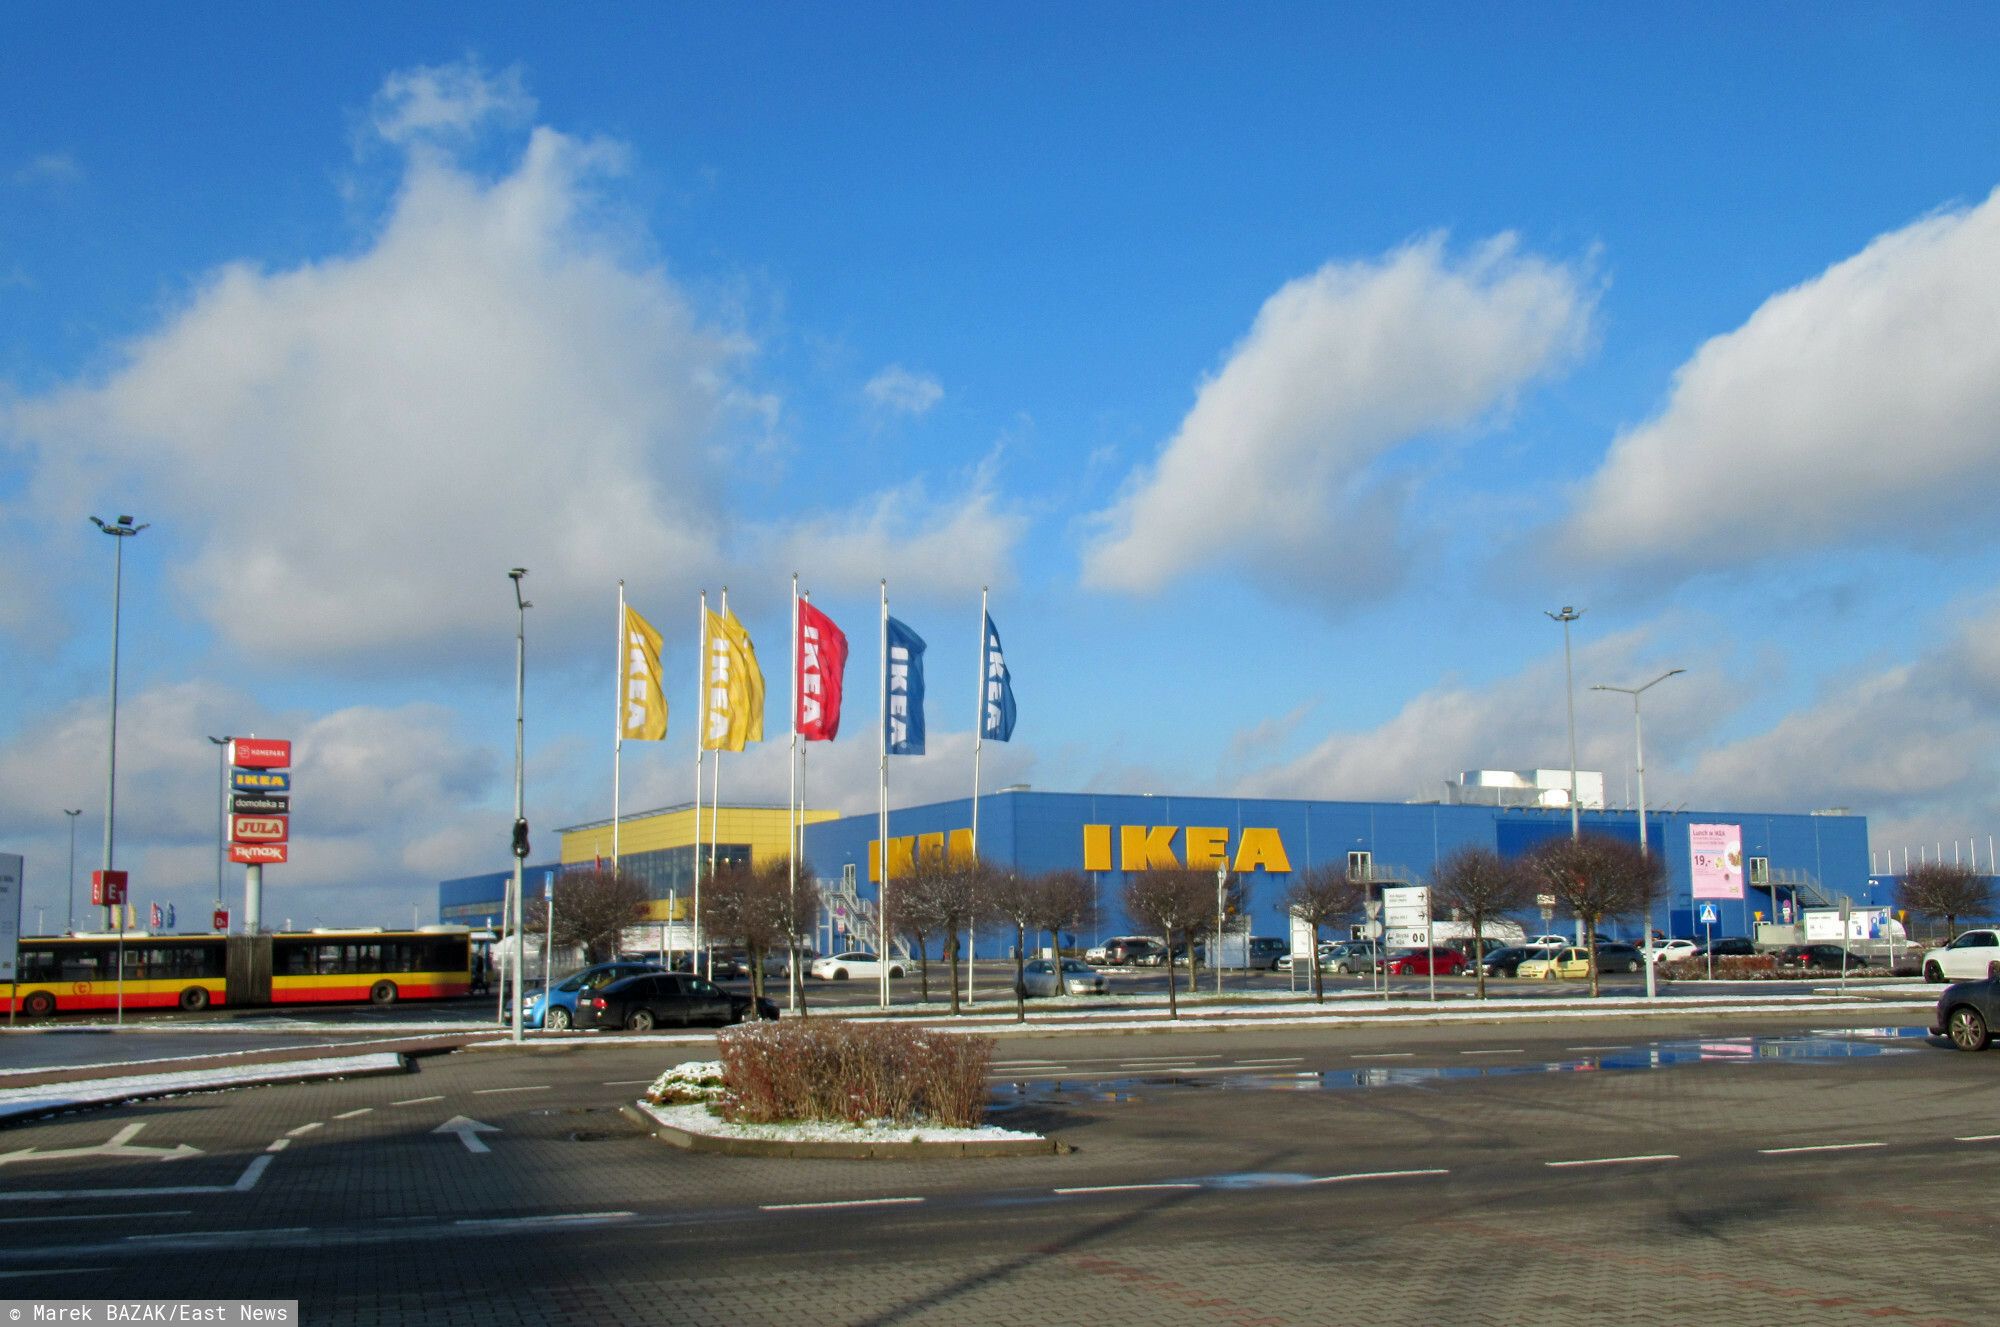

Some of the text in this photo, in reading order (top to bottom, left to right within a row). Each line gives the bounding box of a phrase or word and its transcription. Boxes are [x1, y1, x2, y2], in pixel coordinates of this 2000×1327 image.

[628, 631, 648, 730] IKEA
[709, 638, 730, 740] IKEA
[803, 625, 821, 725] IKEA
[890, 646, 909, 747] IKEA
[987, 634, 1005, 731] IKEA
[236, 775, 285, 786] IKEA
[238, 822, 281, 834] JULA
[868, 828, 978, 883] IKEA
[1083, 824, 1292, 872] IKEA
